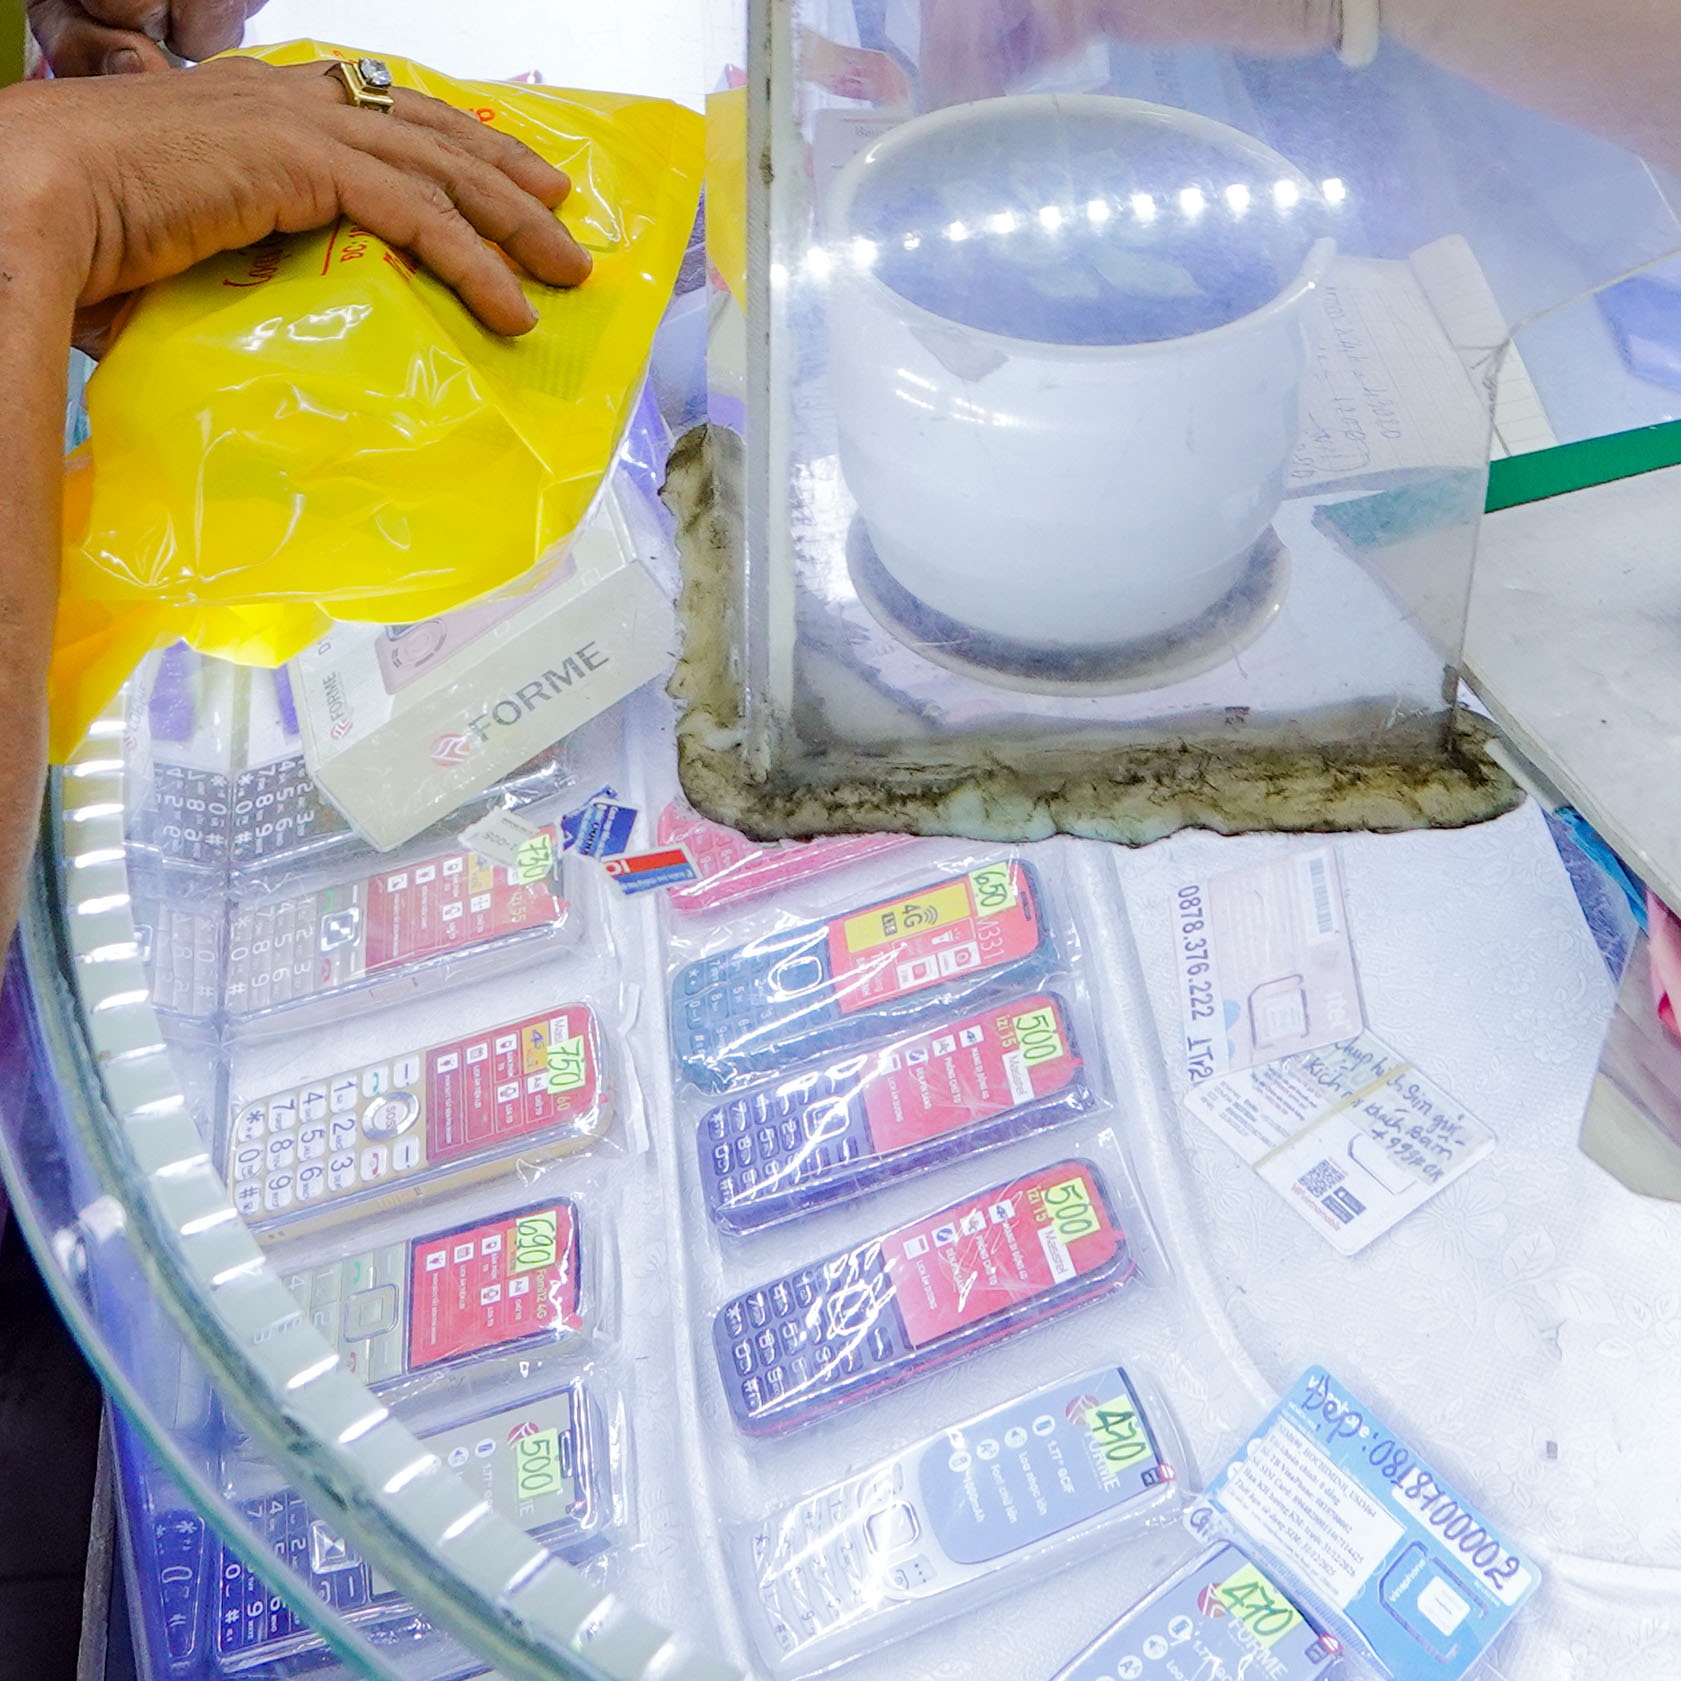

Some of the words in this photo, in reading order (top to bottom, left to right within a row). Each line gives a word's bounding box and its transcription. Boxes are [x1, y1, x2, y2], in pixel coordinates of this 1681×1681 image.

[467, 640, 610, 743] FORME
[1015, 1014, 1057, 1060] 500
[548, 1041, 586, 1090] 750
[1040, 1184, 1095, 1236] 500
[516, 1217, 556, 1268] 690
[517, 1437, 559, 1493] 500
